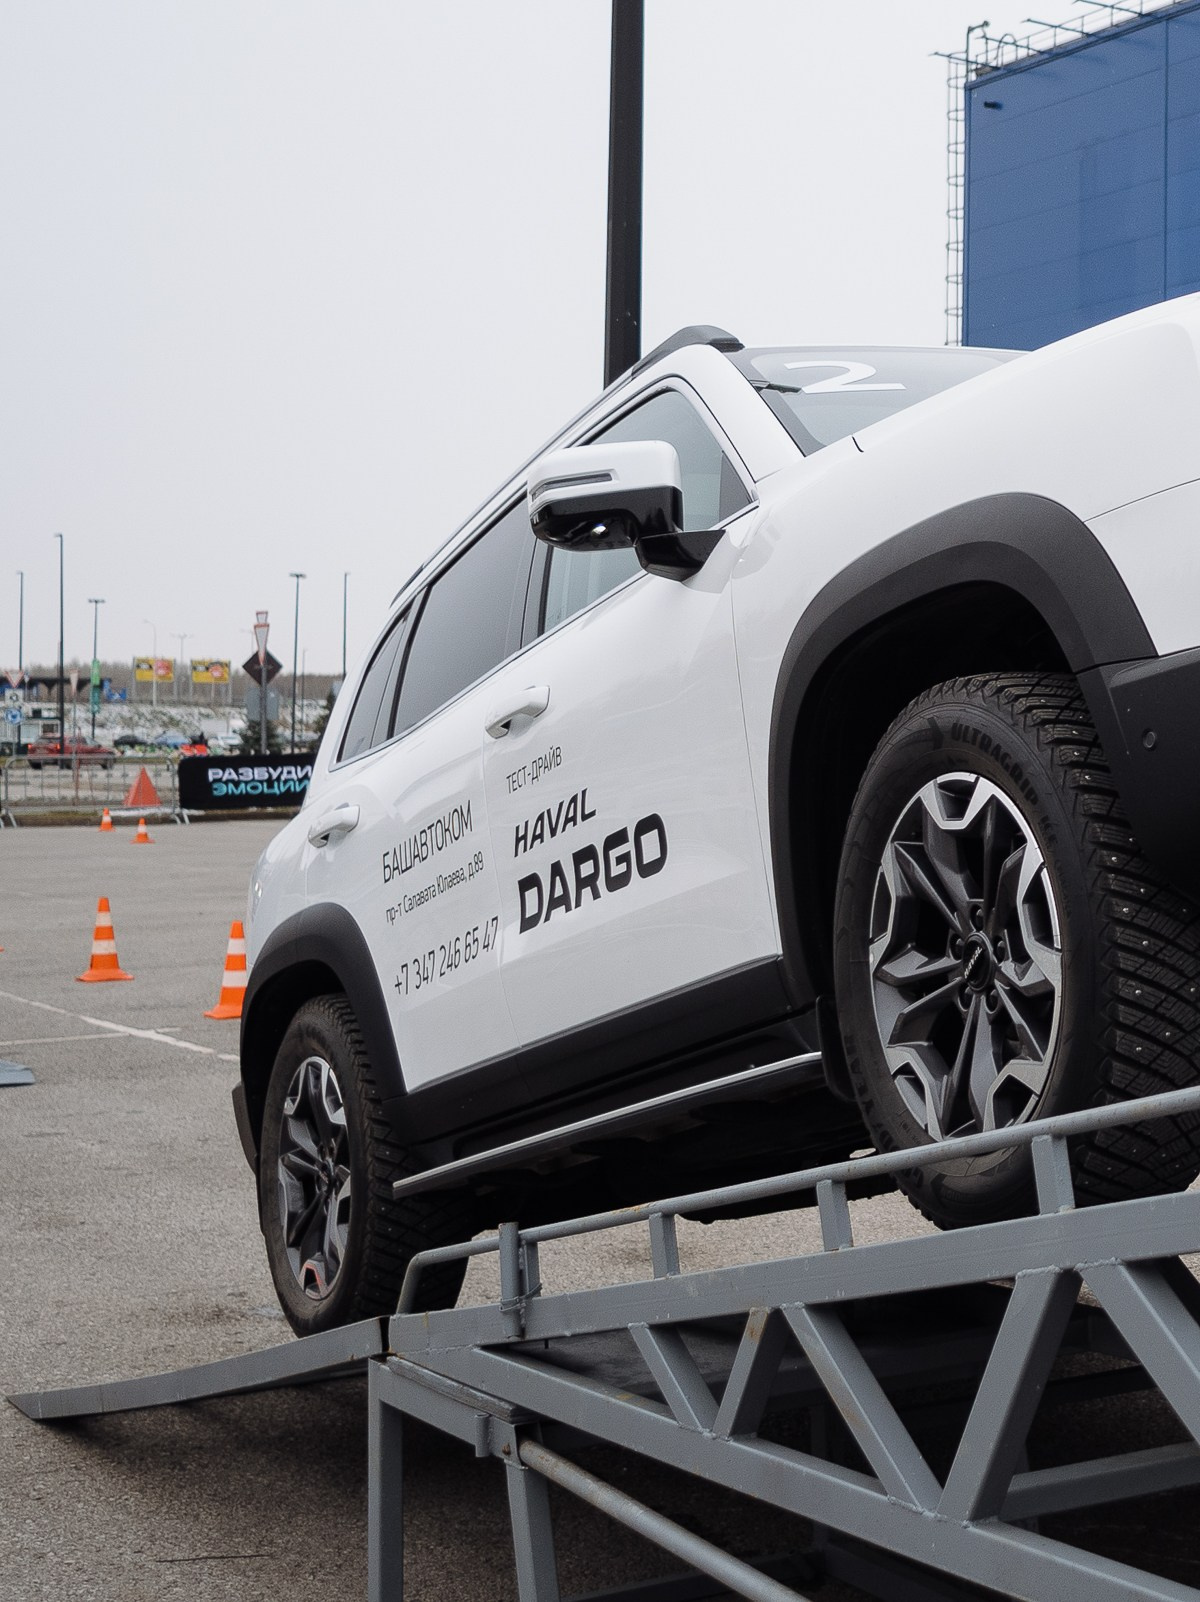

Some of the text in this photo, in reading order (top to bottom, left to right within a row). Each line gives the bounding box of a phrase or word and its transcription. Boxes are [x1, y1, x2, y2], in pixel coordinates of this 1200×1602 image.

[784, 360, 906, 394] 2
[207, 764, 313, 783] РАЗБУДИ
[212, 780, 311, 797] ЭМОЦИИ
[505, 746, 563, 794] ТЕСТ-ДРАЙВ
[951, 722, 1039, 807] ULTRAGRIP
[382, 799, 473, 884] БАШАВТОКОМ
[513, 787, 598, 858] HAVAL
[385, 906, 402, 926] пр-т
[402, 884, 437, 914] Салавата
[467, 850, 484, 881] д.89
[517, 812, 669, 936] DARGO
[394, 915, 499, 995] +7 347 246 65 47
